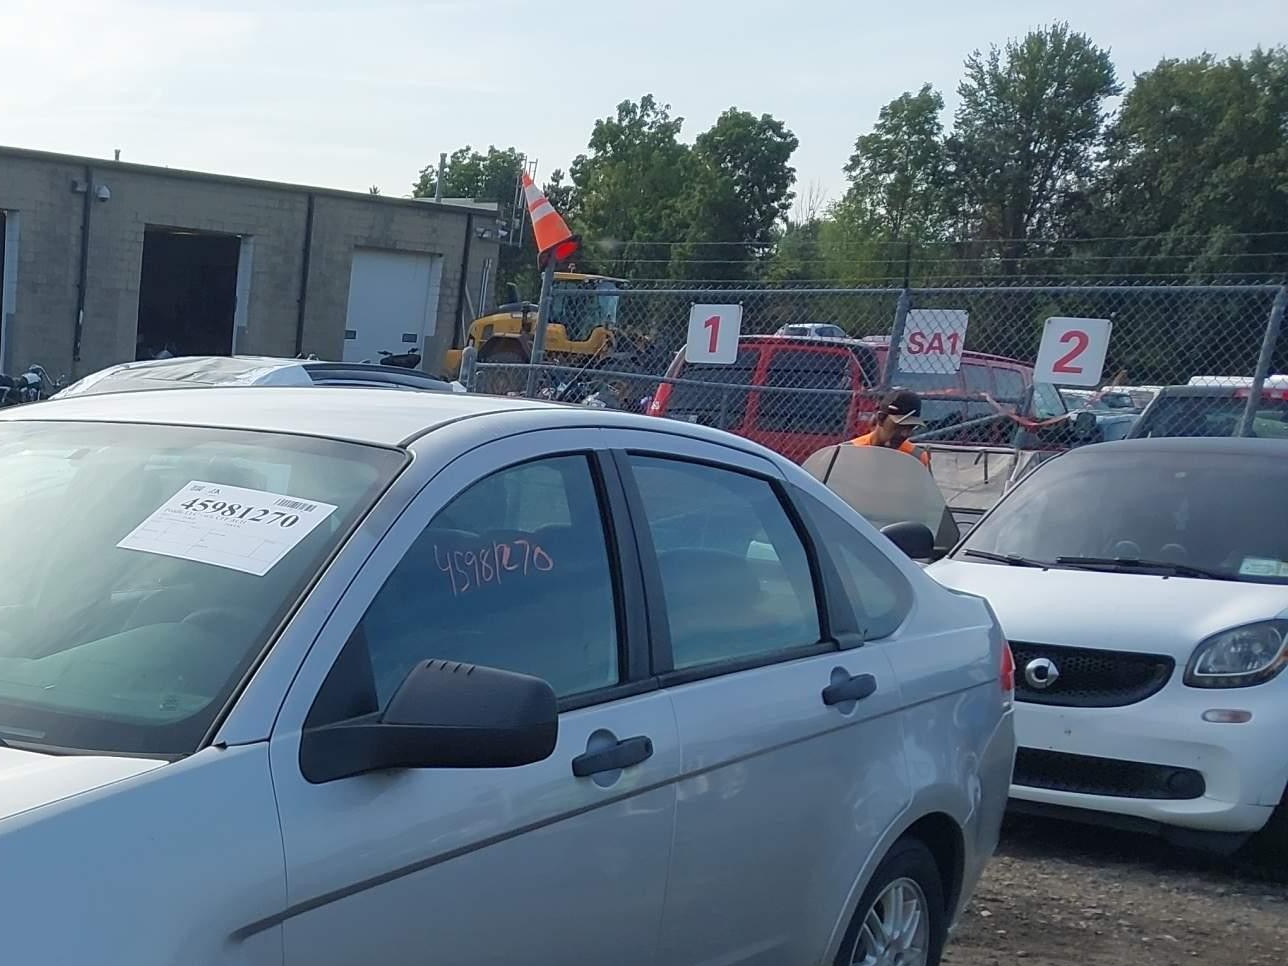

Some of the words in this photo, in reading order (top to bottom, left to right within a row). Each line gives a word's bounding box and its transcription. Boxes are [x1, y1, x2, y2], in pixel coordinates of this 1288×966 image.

[703, 315, 721, 353] 1
[906, 331, 960, 355] SA1
[1051, 329, 1089, 374] 2
[180, 497, 300, 528] 45981270
[433, 539, 554, 597] 45981270
